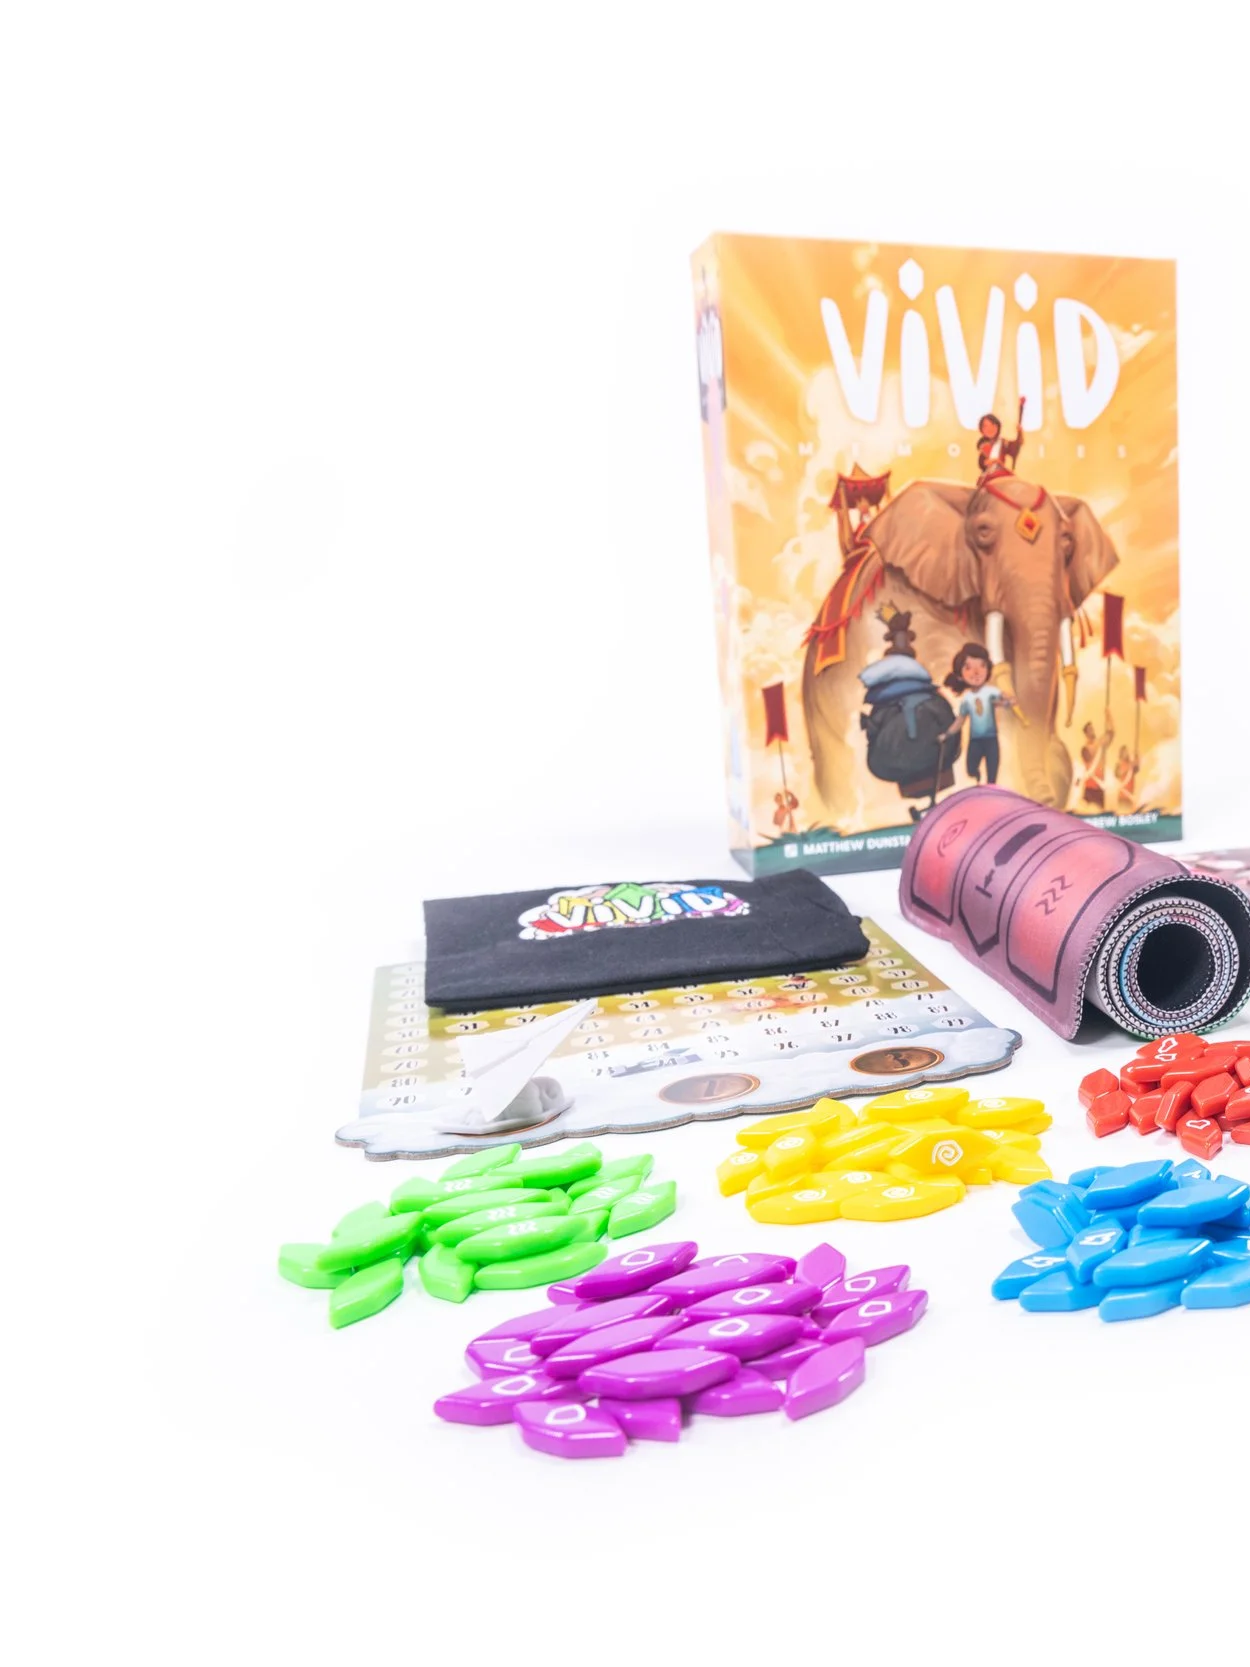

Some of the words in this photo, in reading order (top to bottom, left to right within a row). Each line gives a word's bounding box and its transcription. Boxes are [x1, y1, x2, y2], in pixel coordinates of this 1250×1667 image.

[798, 440, 1127, 460] MEMOIES
[1118, 809, 1158, 828] BOSLEY
[803, 839, 865, 856] MATTHEW
[866, 834, 912, 851] DUNSTA
